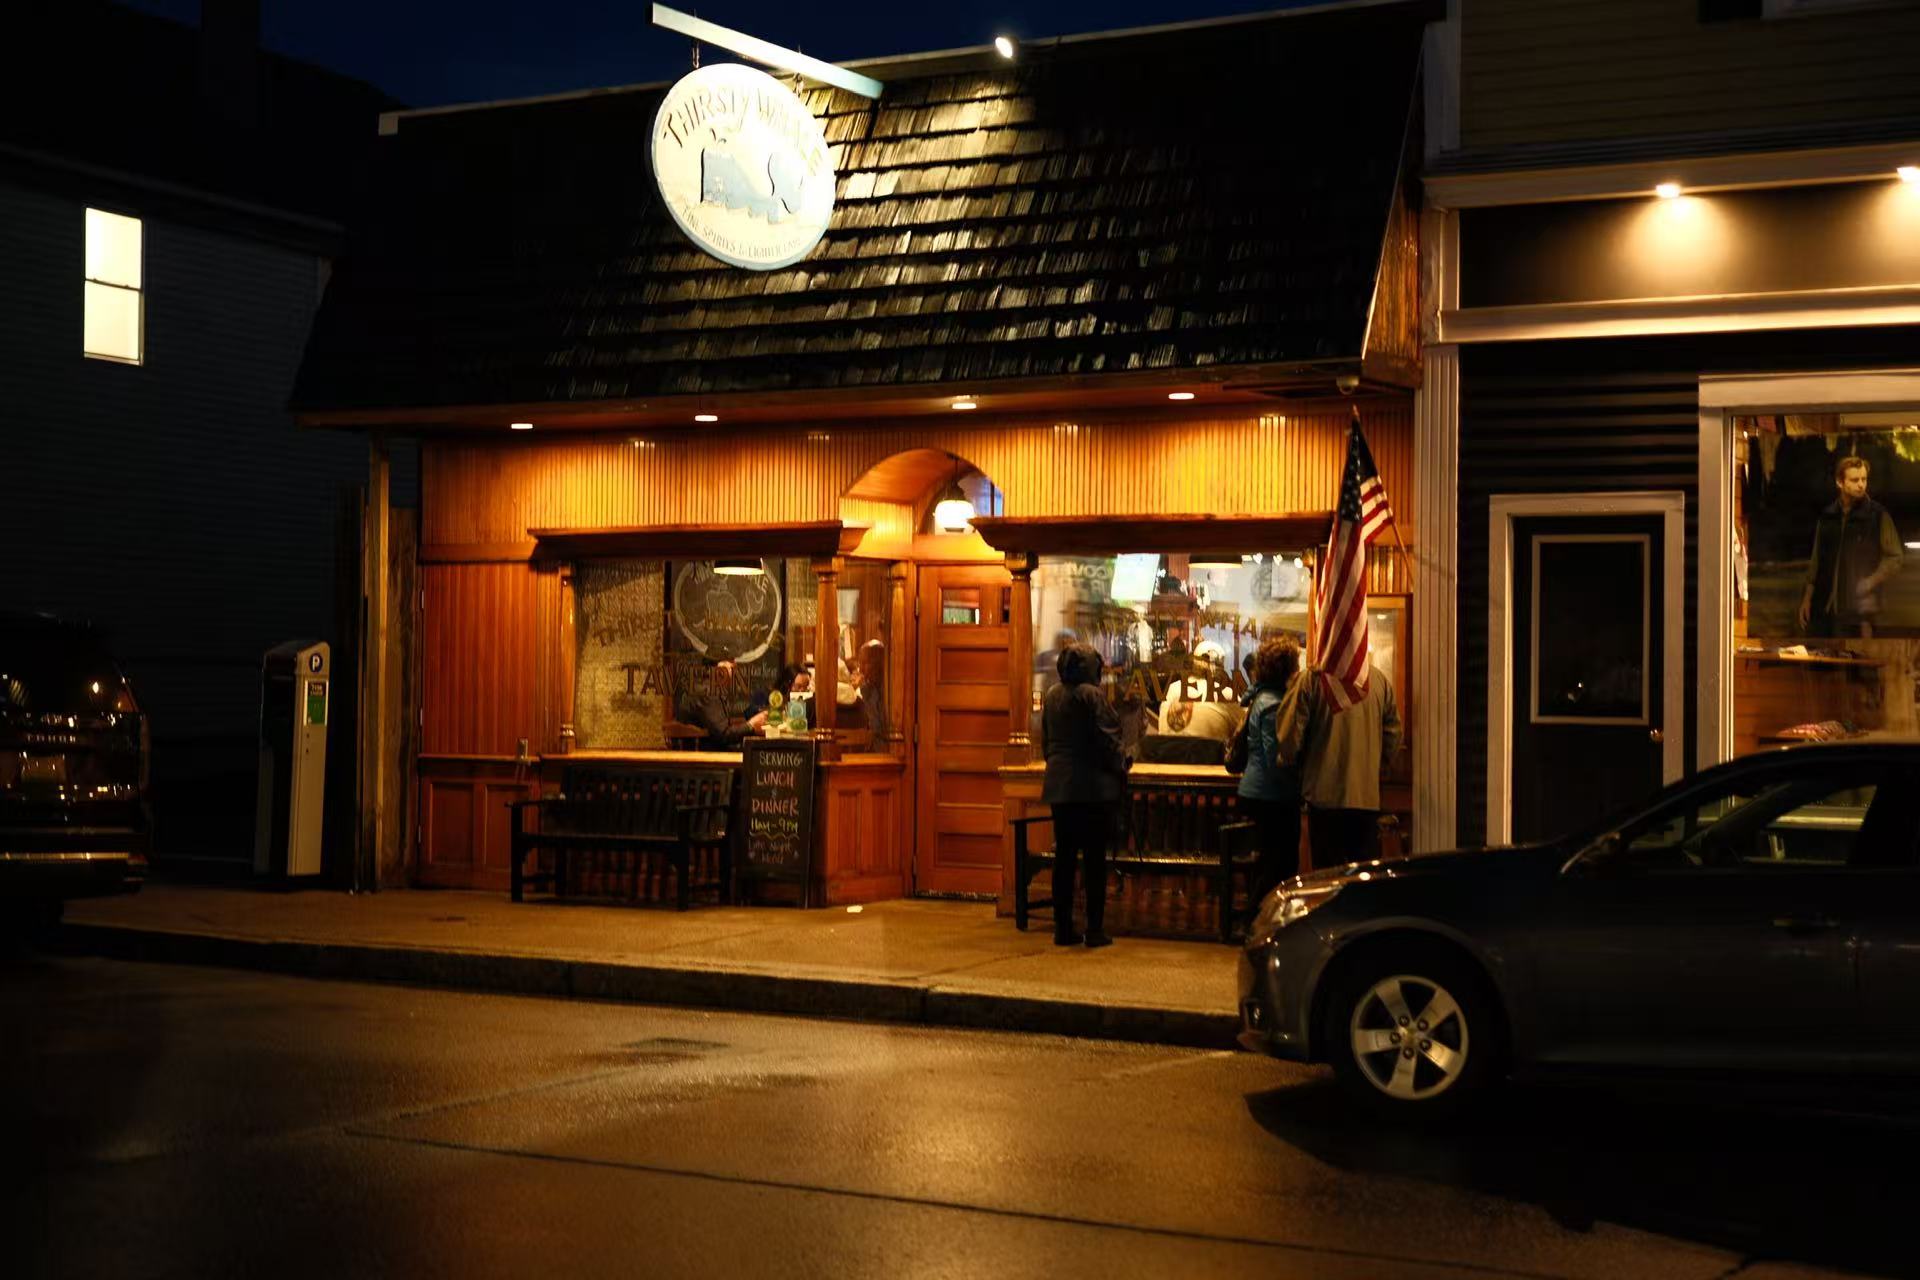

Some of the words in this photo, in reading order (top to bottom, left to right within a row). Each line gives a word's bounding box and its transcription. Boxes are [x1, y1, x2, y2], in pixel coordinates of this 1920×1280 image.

[312, 655, 320, 671] P
[621, 662, 753, 696] TAVERN
[1101, 665, 1251, 702] TAVERN
[759, 751, 801, 767] SERVING
[756, 770, 795, 788] LUNCH
[751, 797, 800, 817] DINNER
